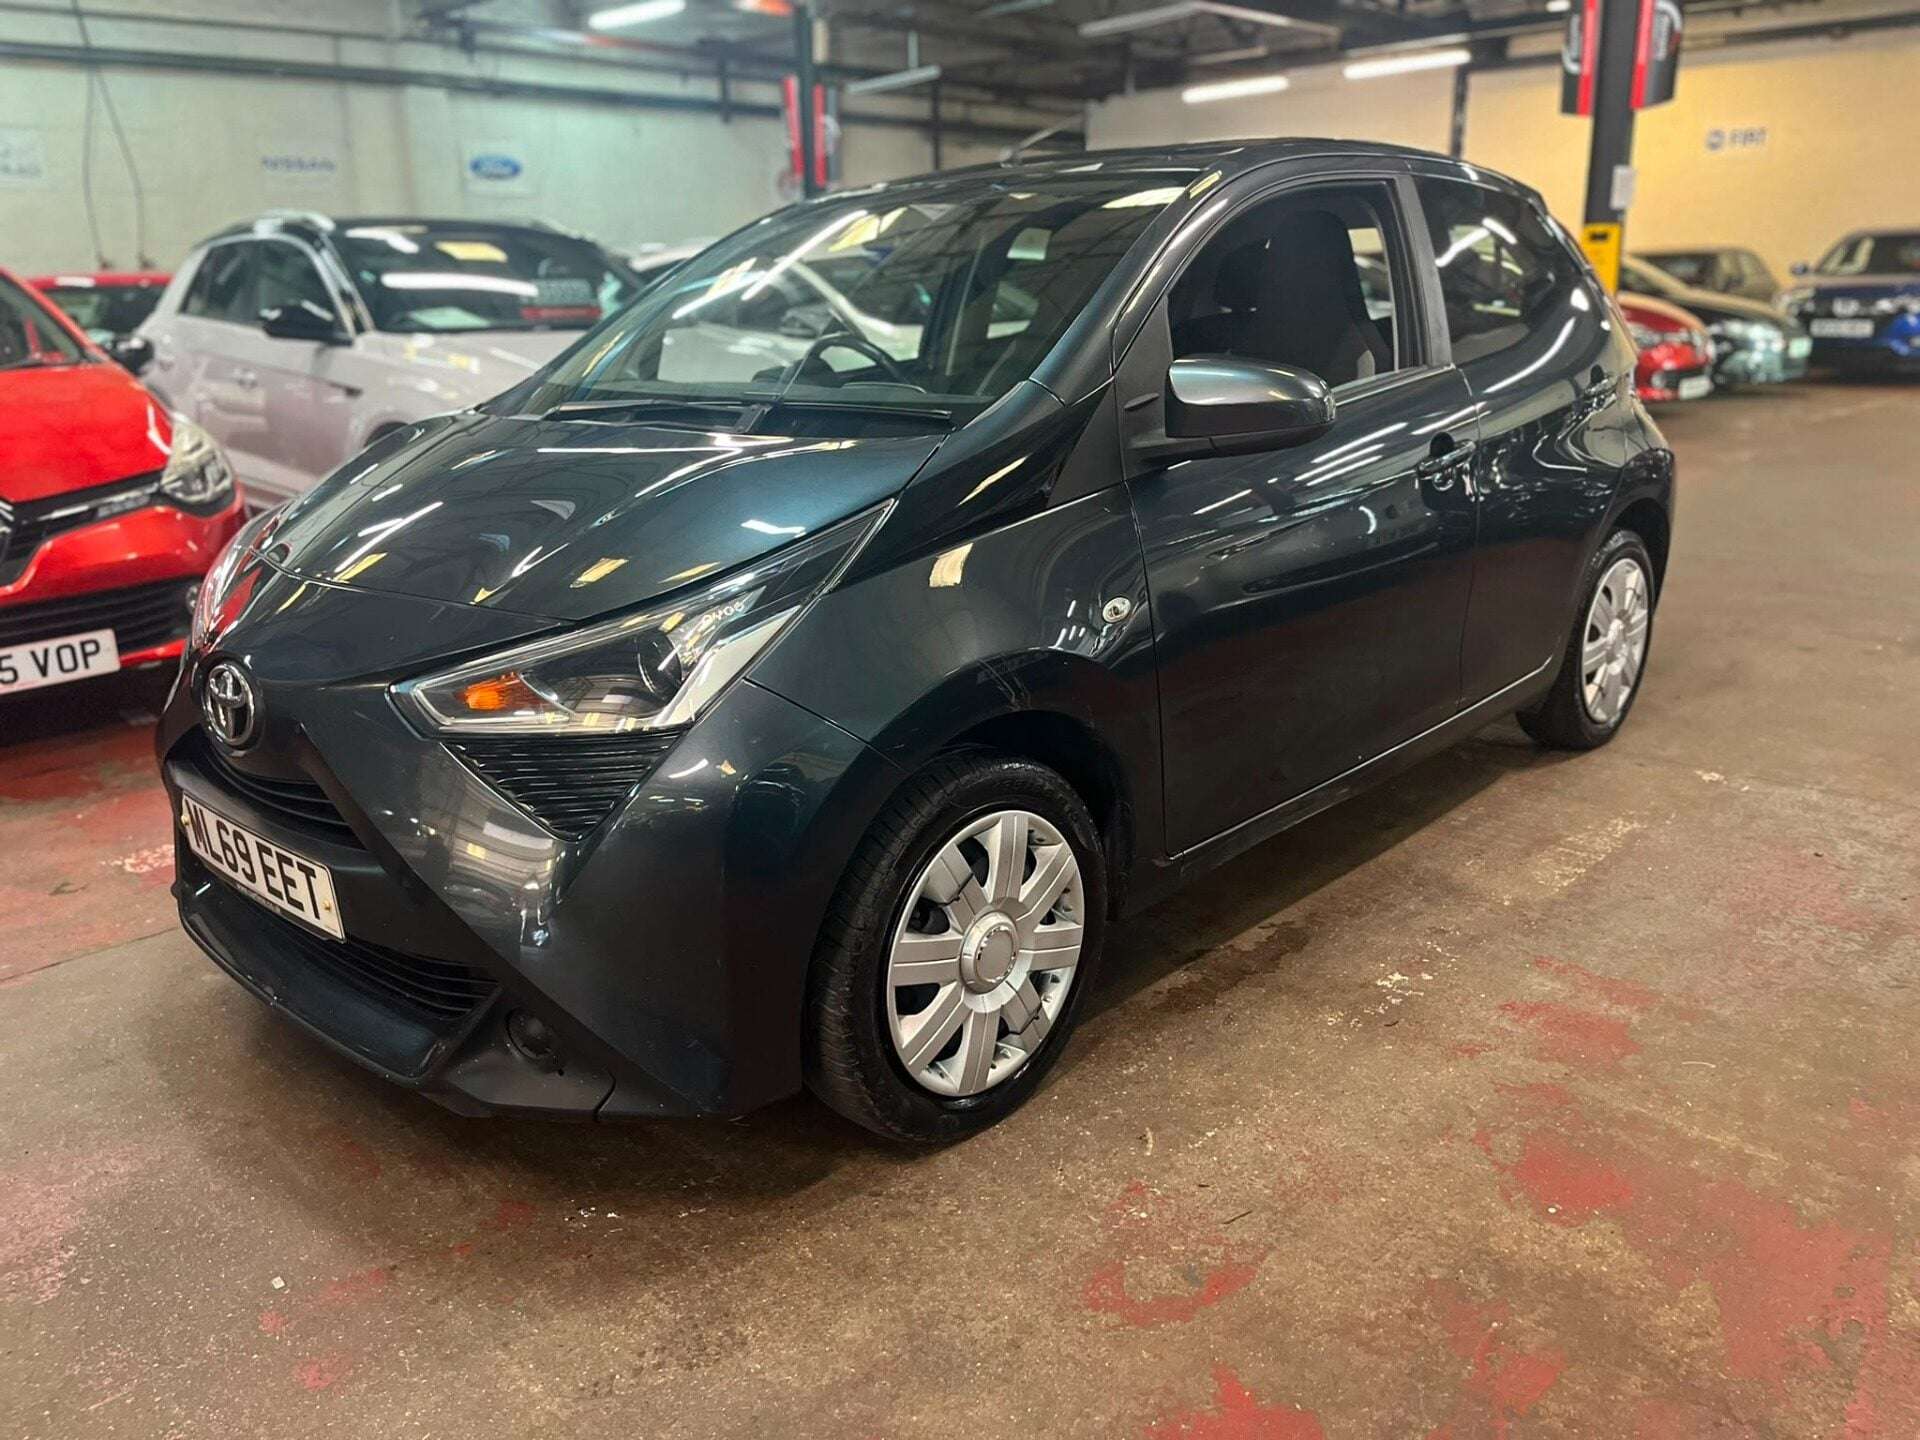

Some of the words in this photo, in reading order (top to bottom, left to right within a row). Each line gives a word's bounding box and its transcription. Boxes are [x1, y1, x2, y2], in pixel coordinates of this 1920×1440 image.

[30, 638, 100, 677] VOP
[184, 799, 257, 884] NL69
[255, 840, 320, 920] EET
